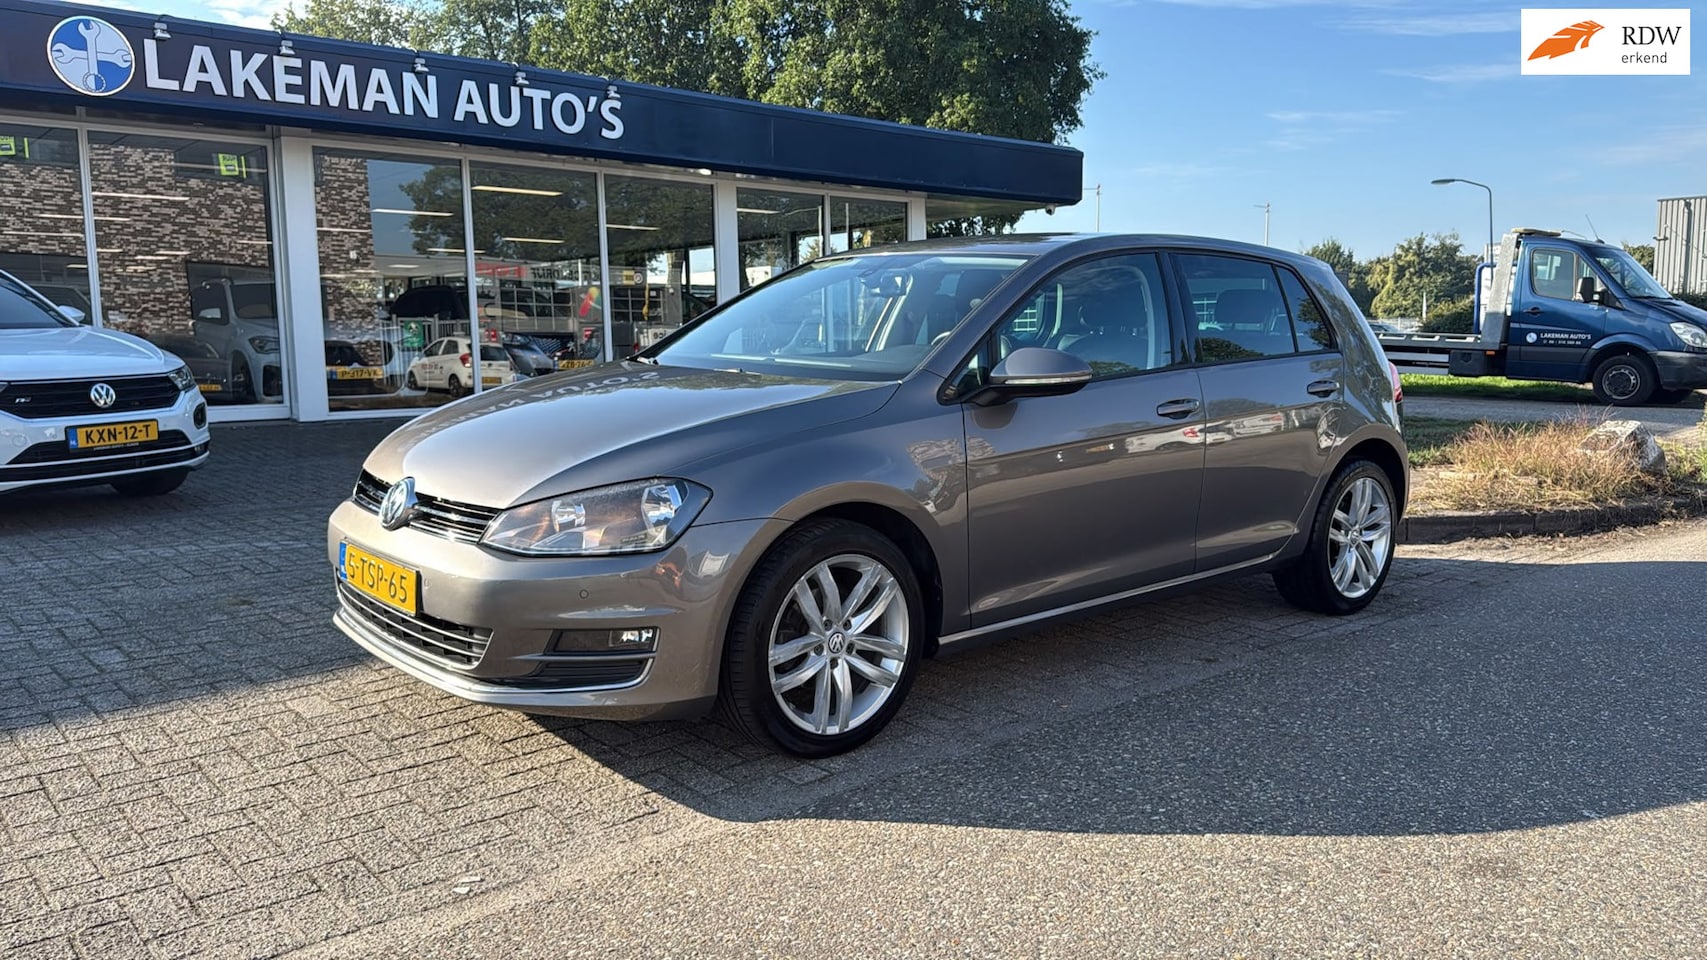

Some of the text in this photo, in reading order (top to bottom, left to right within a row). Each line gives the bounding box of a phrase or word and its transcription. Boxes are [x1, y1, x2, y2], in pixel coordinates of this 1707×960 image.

[143, 39, 624, 140] LAKEMAN AUTO'S
[90, 383, 116, 407] VW
[85, 424, 151, 444] KXN-12-T
[348, 552, 407, 603] 5-TSP-65
